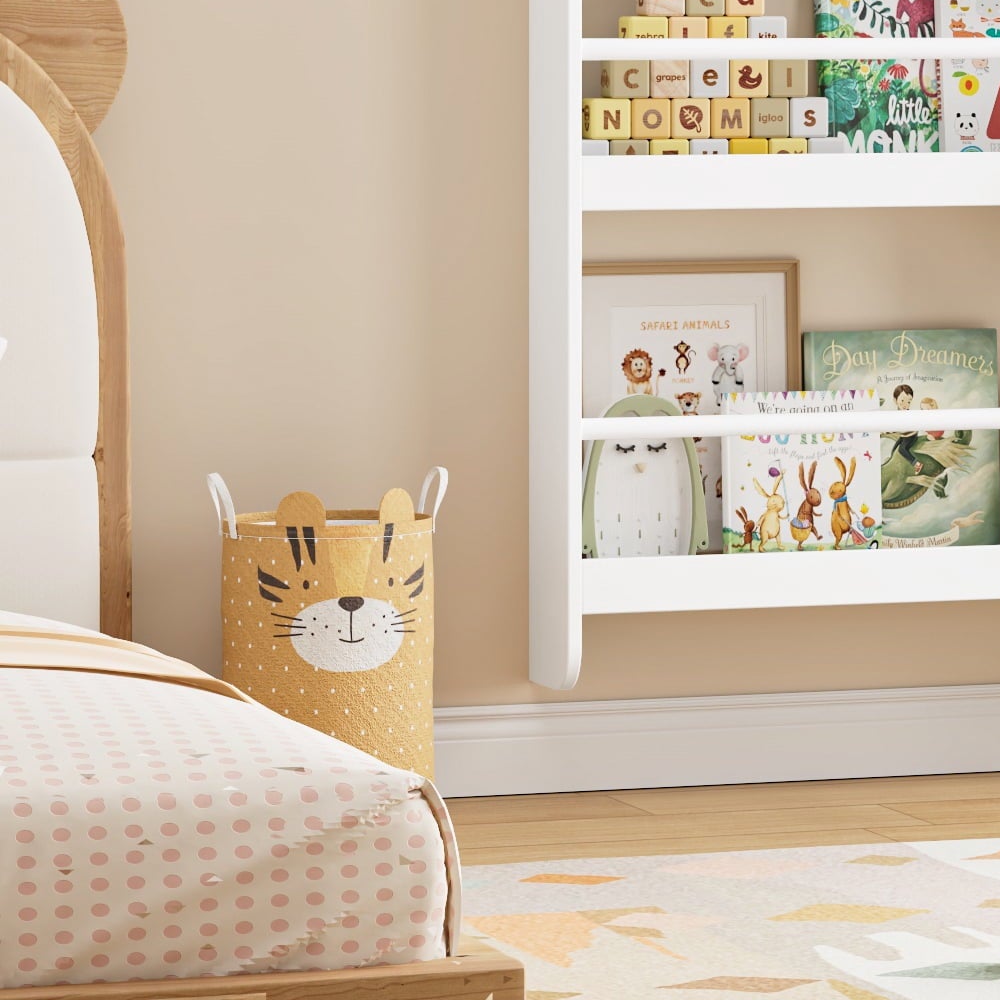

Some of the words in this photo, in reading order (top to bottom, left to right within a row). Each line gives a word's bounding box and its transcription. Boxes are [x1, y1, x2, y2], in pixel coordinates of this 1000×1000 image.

[656, 73, 687, 83] grapes
[702, 69, 719, 87] e
[720, 108, 743, 129] M
[758, 112, 784, 124] igloo
[886, 94, 932, 126] little
[603, 109, 620, 130] N
[640, 320, 678, 331] SAFARI
[682, 319, 730, 330] ANIMALS
[822, 339, 878, 380] Day
[887, 330, 994, 377] Dreamers
[757, 402, 786, 414] We're
[823, 403, 838, 413] on
[840, 402, 854, 411] an
